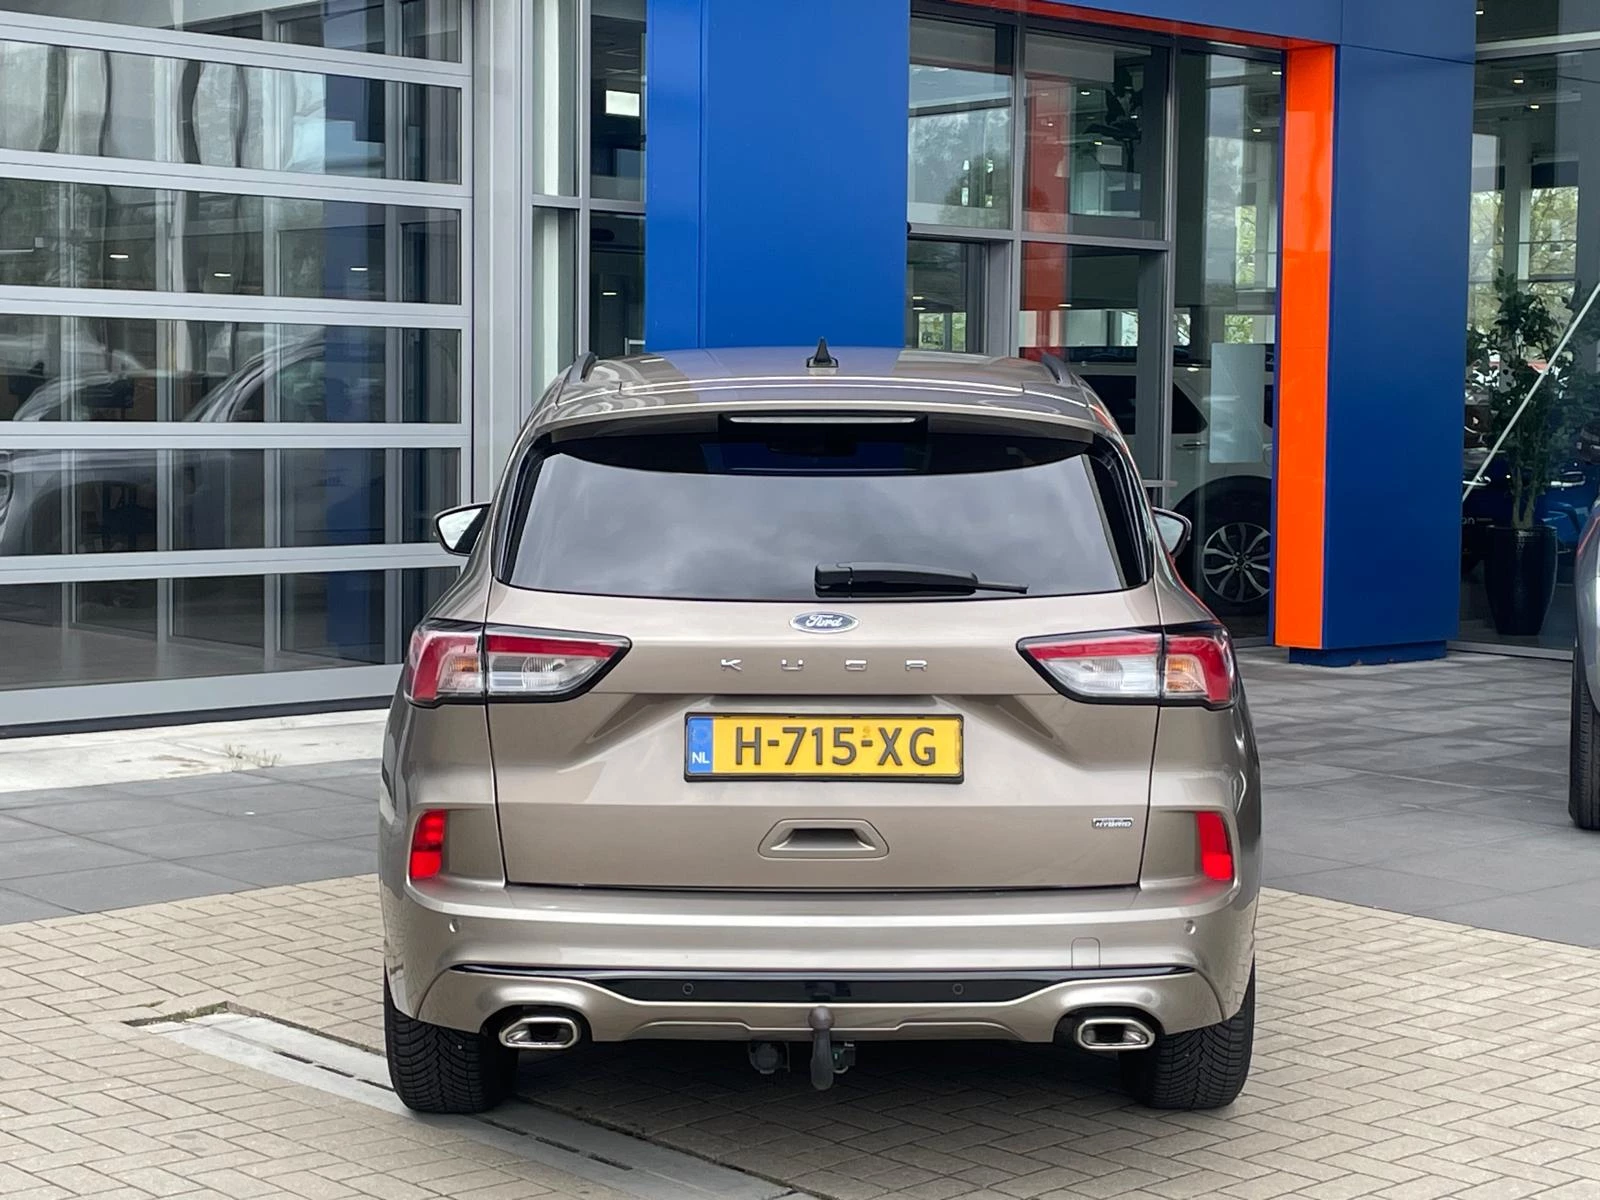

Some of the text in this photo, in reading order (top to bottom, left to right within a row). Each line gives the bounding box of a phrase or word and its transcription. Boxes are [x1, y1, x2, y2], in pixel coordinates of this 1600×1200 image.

[805, 614, 844, 628] Ford
[720, 658, 929, 672] KUGA
[735, 726, 937, 767] H-715-XG
[691, 751, 711, 765] NL
